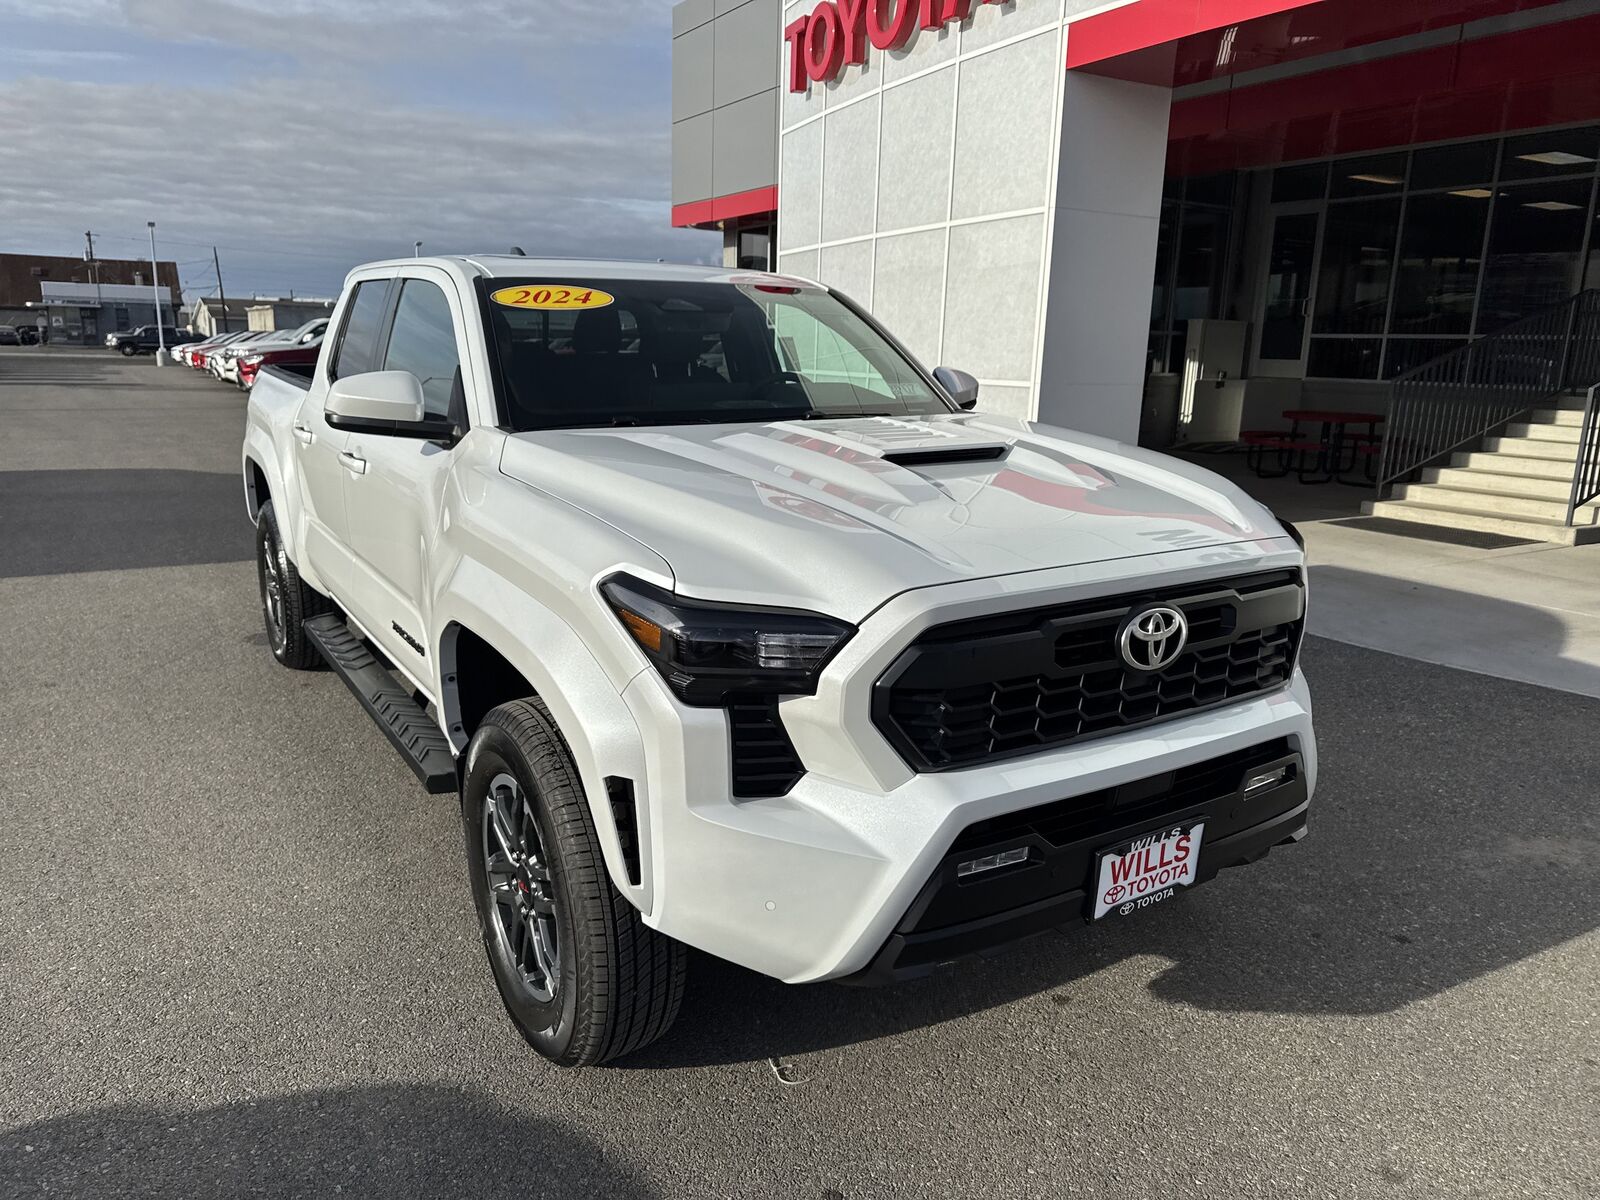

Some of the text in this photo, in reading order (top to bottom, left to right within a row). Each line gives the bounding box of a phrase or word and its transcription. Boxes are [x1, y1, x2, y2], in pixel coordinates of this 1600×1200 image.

[784, 0, 1009, 93] TOYO
[511, 289, 593, 304] 2024
[1131, 827, 1182, 852] WILLS
[1111, 834, 1191, 885] WILLS
[1127, 863, 1189, 896] TOYOTA
[1137, 887, 1174, 909] TOYOTA
